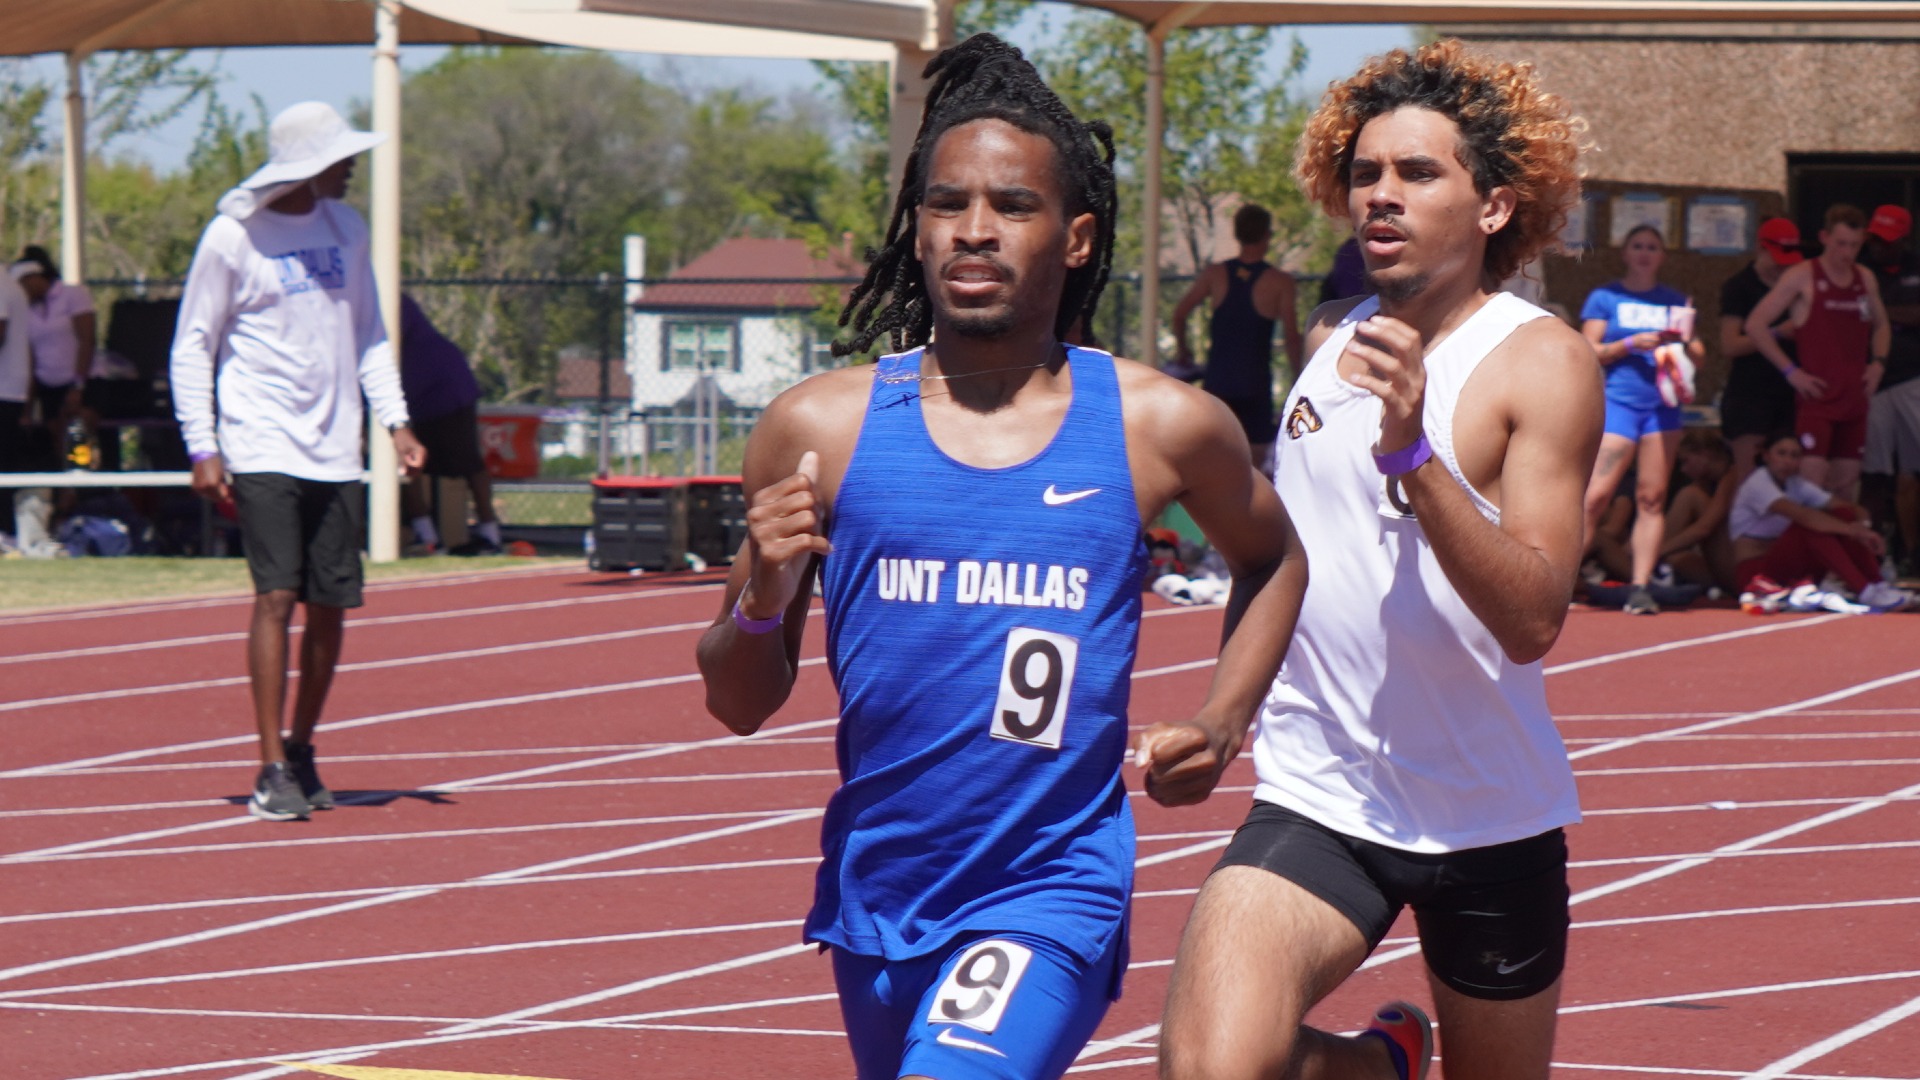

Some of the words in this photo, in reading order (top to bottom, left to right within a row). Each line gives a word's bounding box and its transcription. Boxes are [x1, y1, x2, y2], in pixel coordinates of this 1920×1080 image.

[878, 558, 946, 603] UNT
[956, 561, 1089, 610] DALLAS
[1002, 638, 1063, 739] 9
[941, 946, 1010, 1020] 9
